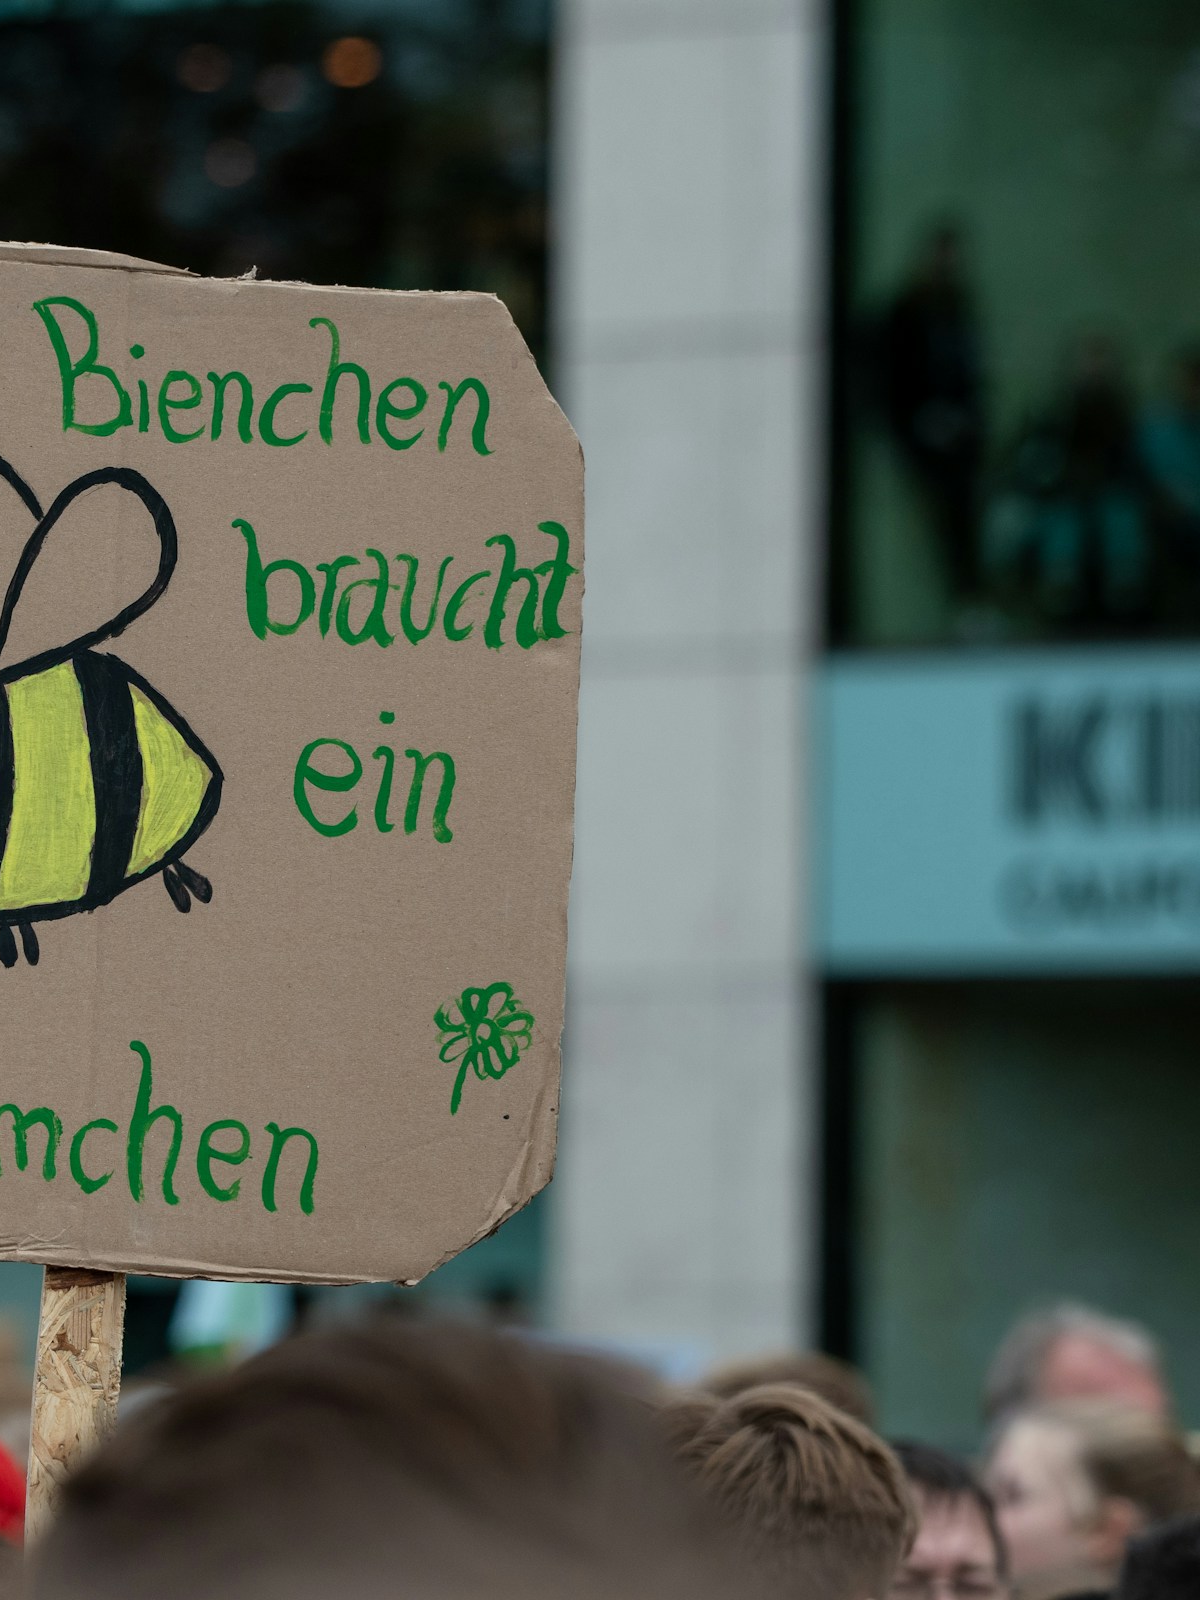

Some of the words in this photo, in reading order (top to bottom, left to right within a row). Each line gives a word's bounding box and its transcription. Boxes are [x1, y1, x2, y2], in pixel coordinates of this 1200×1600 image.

[32, 295, 492, 457] Bienchen
[230, 517, 578, 650] braucht
[293, 710, 457, 844] ein
